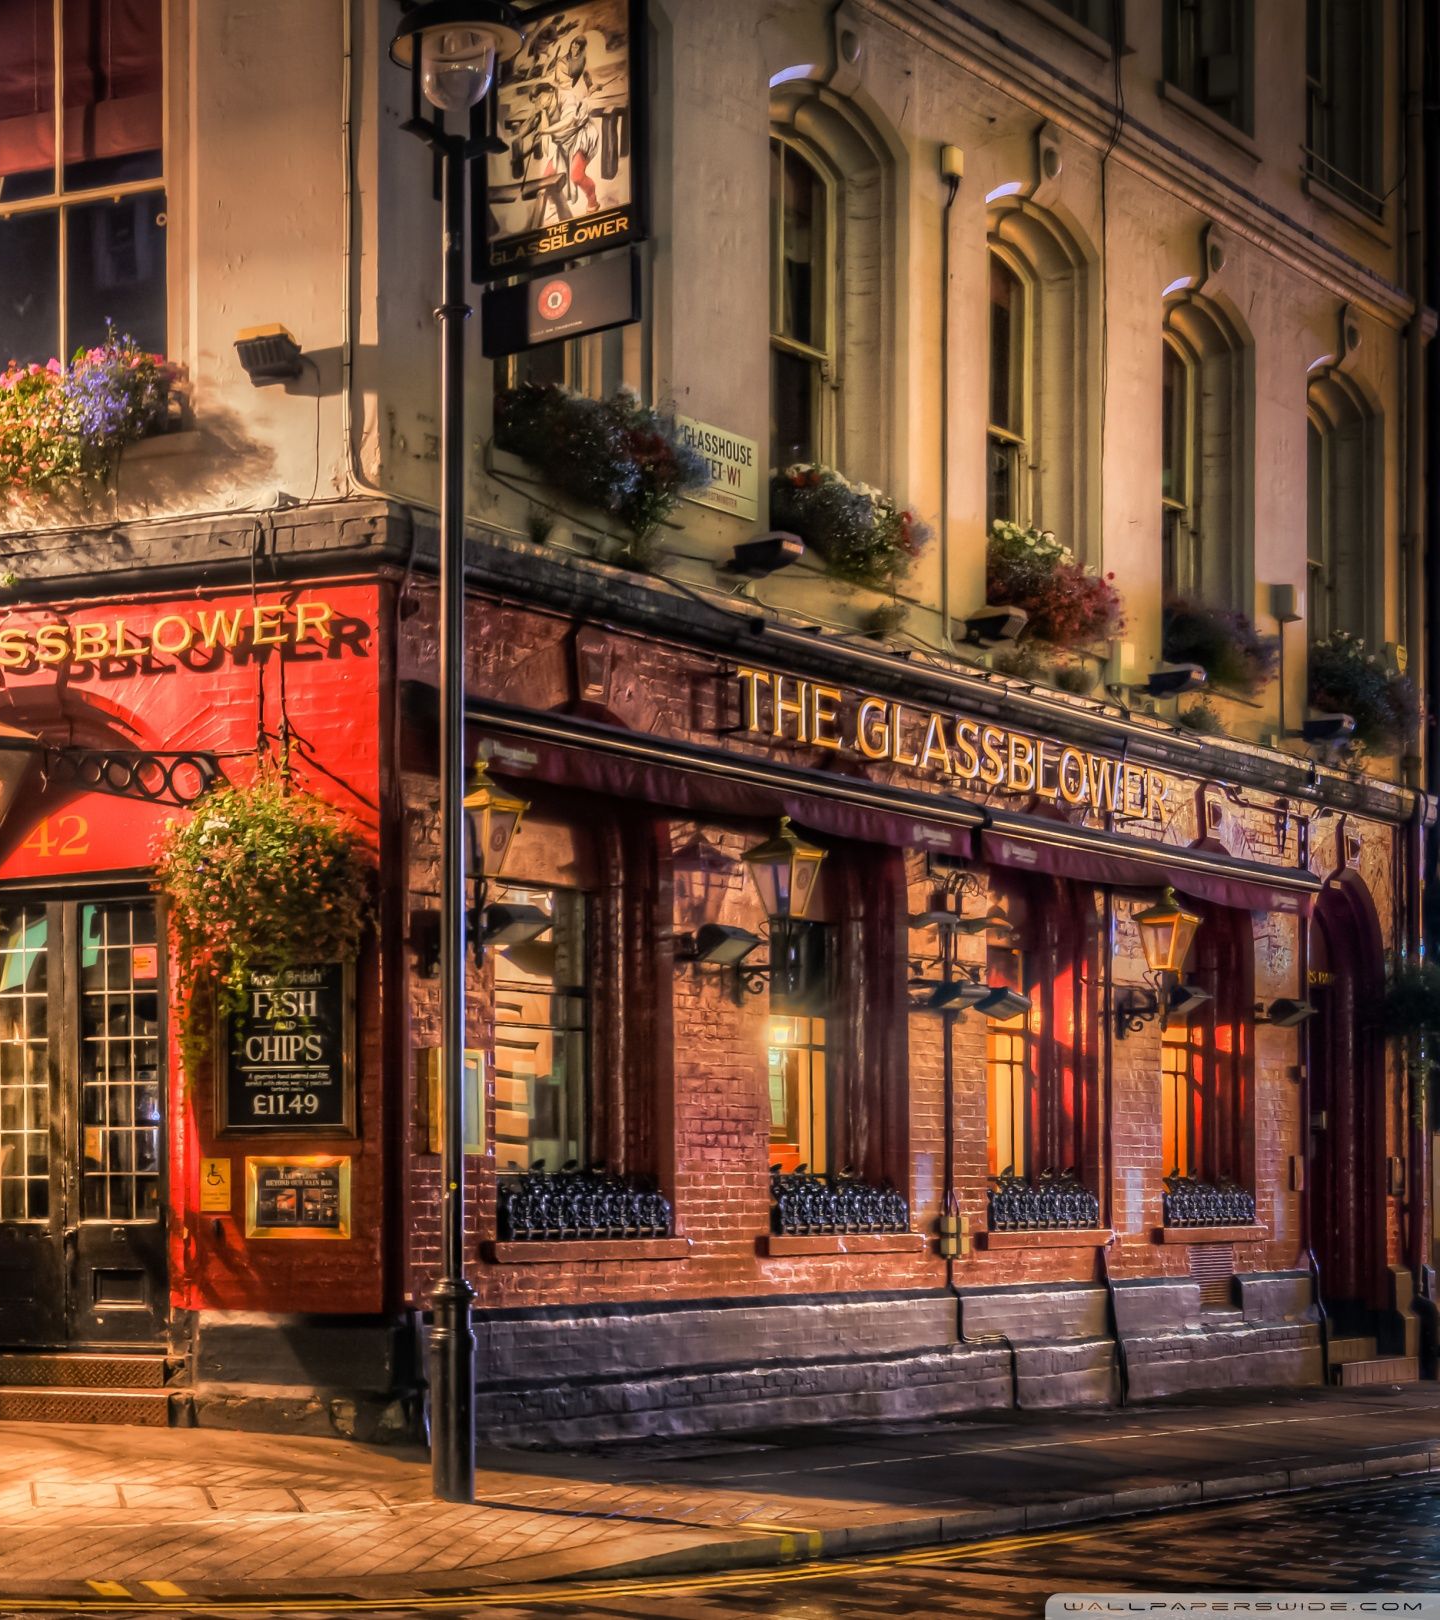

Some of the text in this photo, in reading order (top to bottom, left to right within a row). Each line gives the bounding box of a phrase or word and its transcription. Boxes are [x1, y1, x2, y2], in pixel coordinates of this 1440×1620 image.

[490, 217, 629, 266] GLASSBLOWER
[547, 223, 569, 236] THE
[684, 425, 753, 467] GLASSHOUSE
[727, 465, 741, 488] W1
[737, 665, 1169, 821] THE GLASSBLOWER
[22, 814, 90, 857] 42
[252, 991, 318, 1018] FISH
[245, 1035, 323, 1062] CHIPS
[253, 1093, 319, 1115] £11.49
